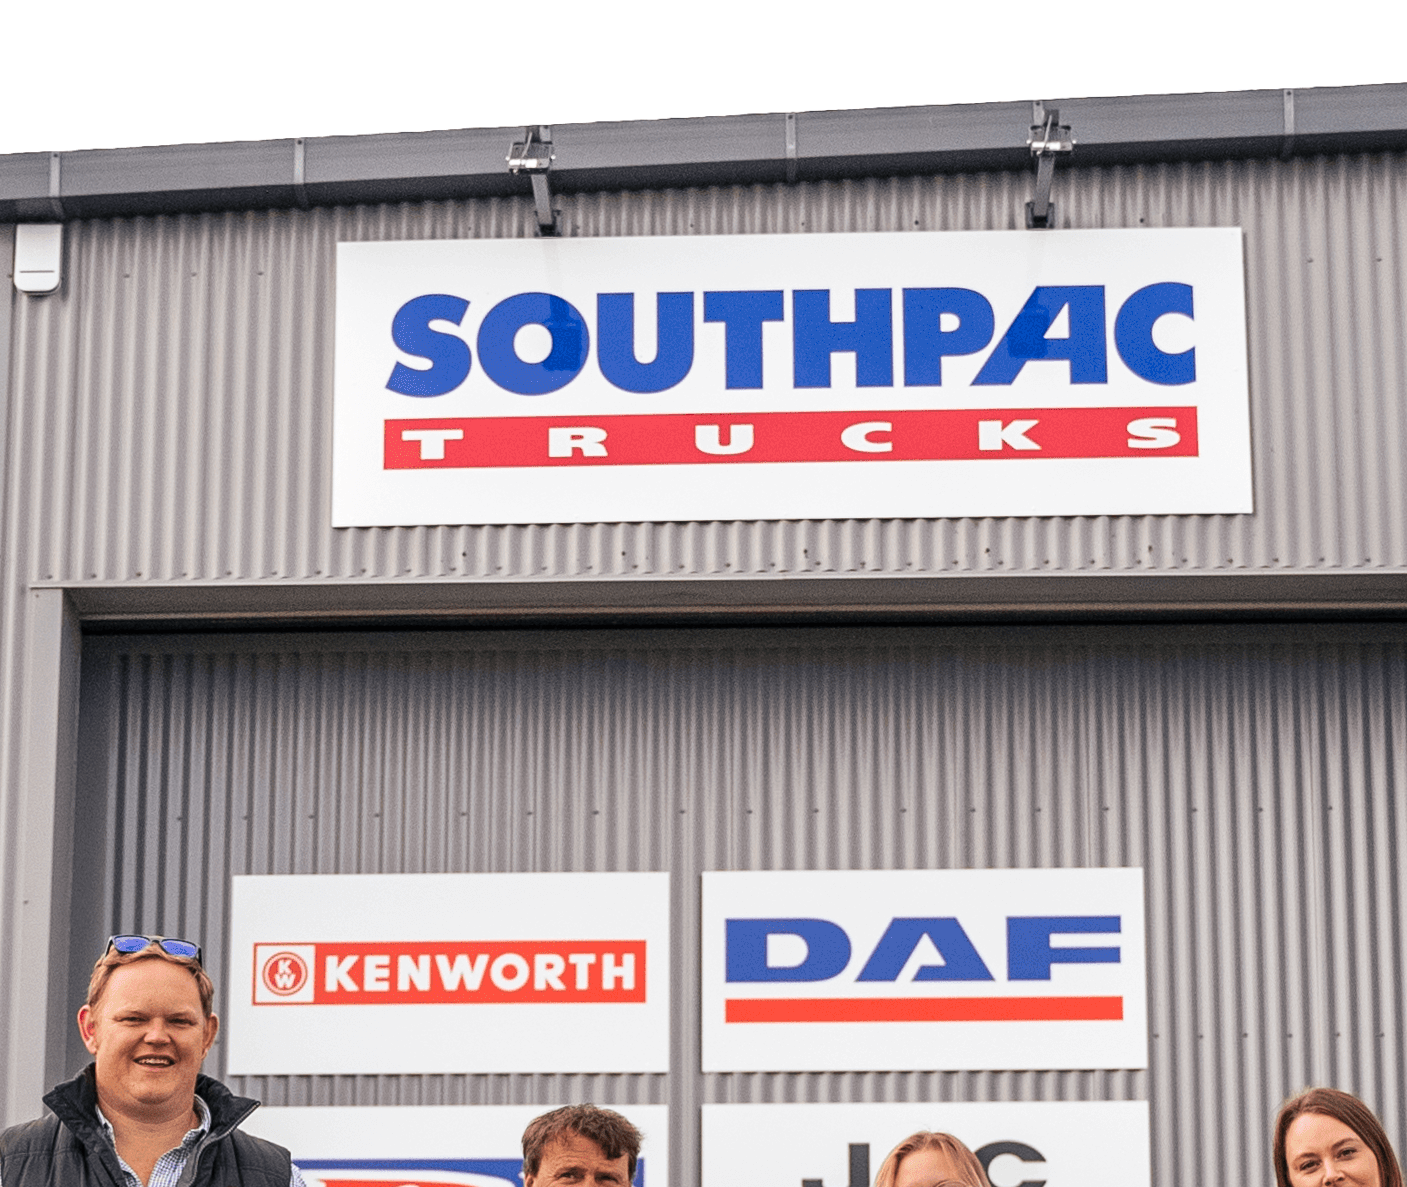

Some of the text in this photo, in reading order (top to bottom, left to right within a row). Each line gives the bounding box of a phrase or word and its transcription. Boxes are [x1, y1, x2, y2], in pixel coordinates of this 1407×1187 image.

[385, 282, 1197, 397] SOUTHPAC
[401, 417, 1181, 461] TRUCKS
[324, 952, 636, 993] KENWORTH
[725, 915, 1122, 983] DAF
